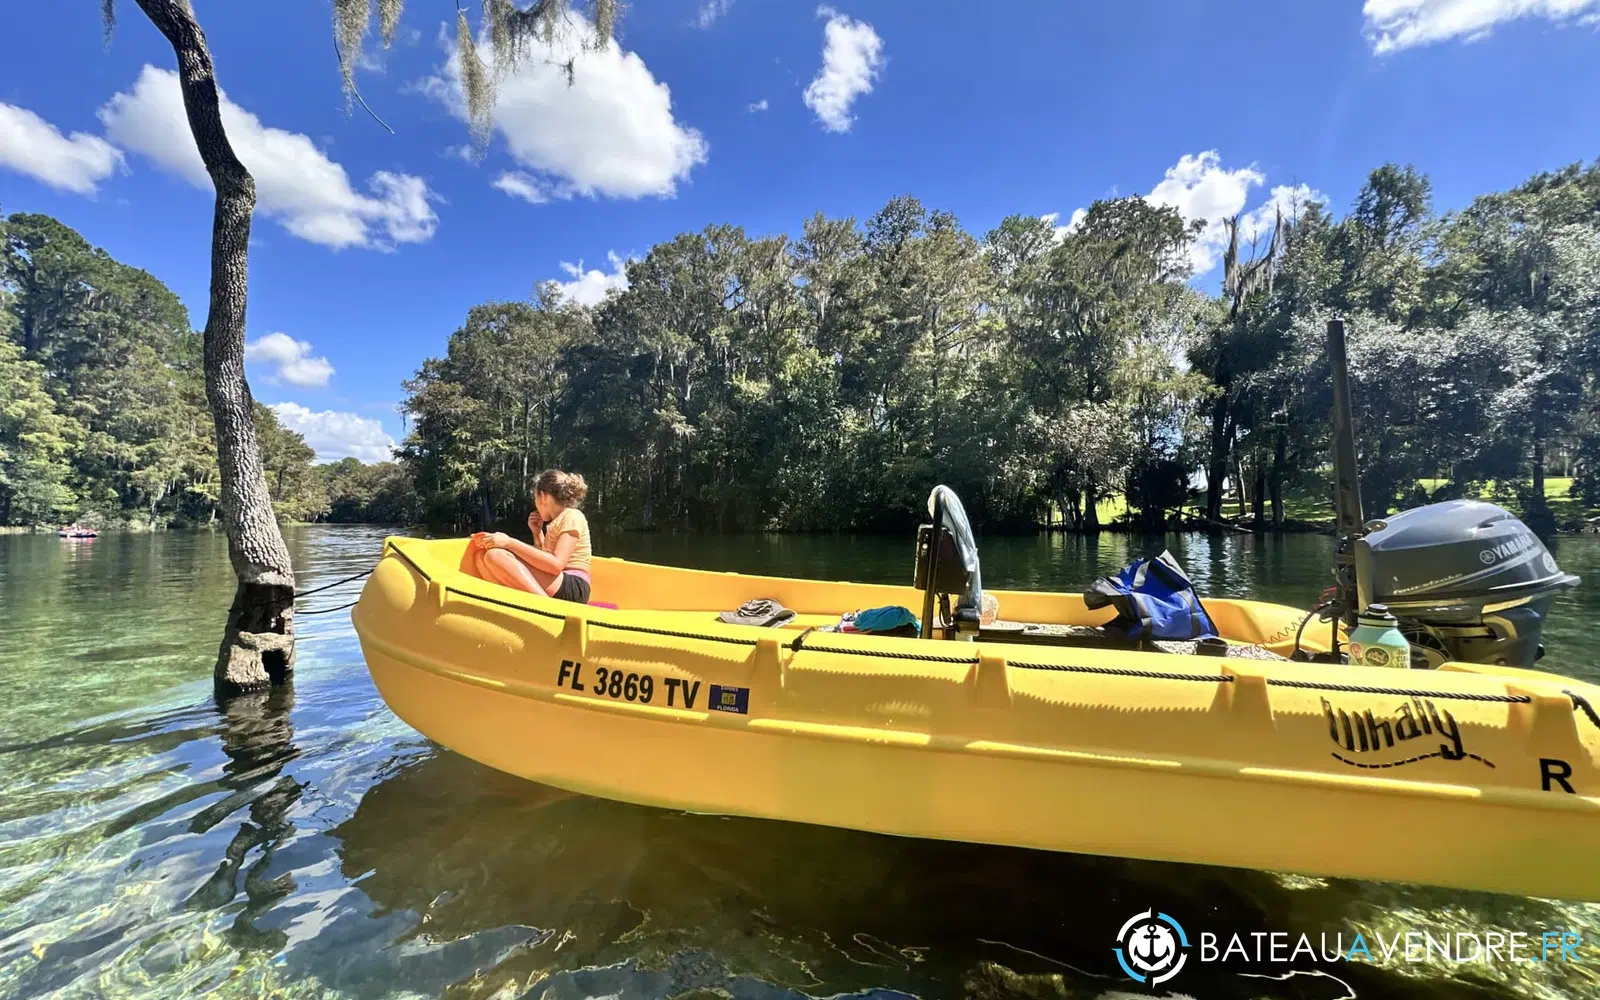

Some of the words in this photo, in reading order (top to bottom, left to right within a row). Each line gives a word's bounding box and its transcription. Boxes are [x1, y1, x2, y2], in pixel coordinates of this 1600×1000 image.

[1492, 533, 1534, 559] YAMAHA
[557, 659, 585, 691] FL
[593, 667, 654, 704] 3869
[663, 677, 701, 709] TV
[716, 705, 739, 713] FLORIDA
[1539, 758, 1576, 794] R
